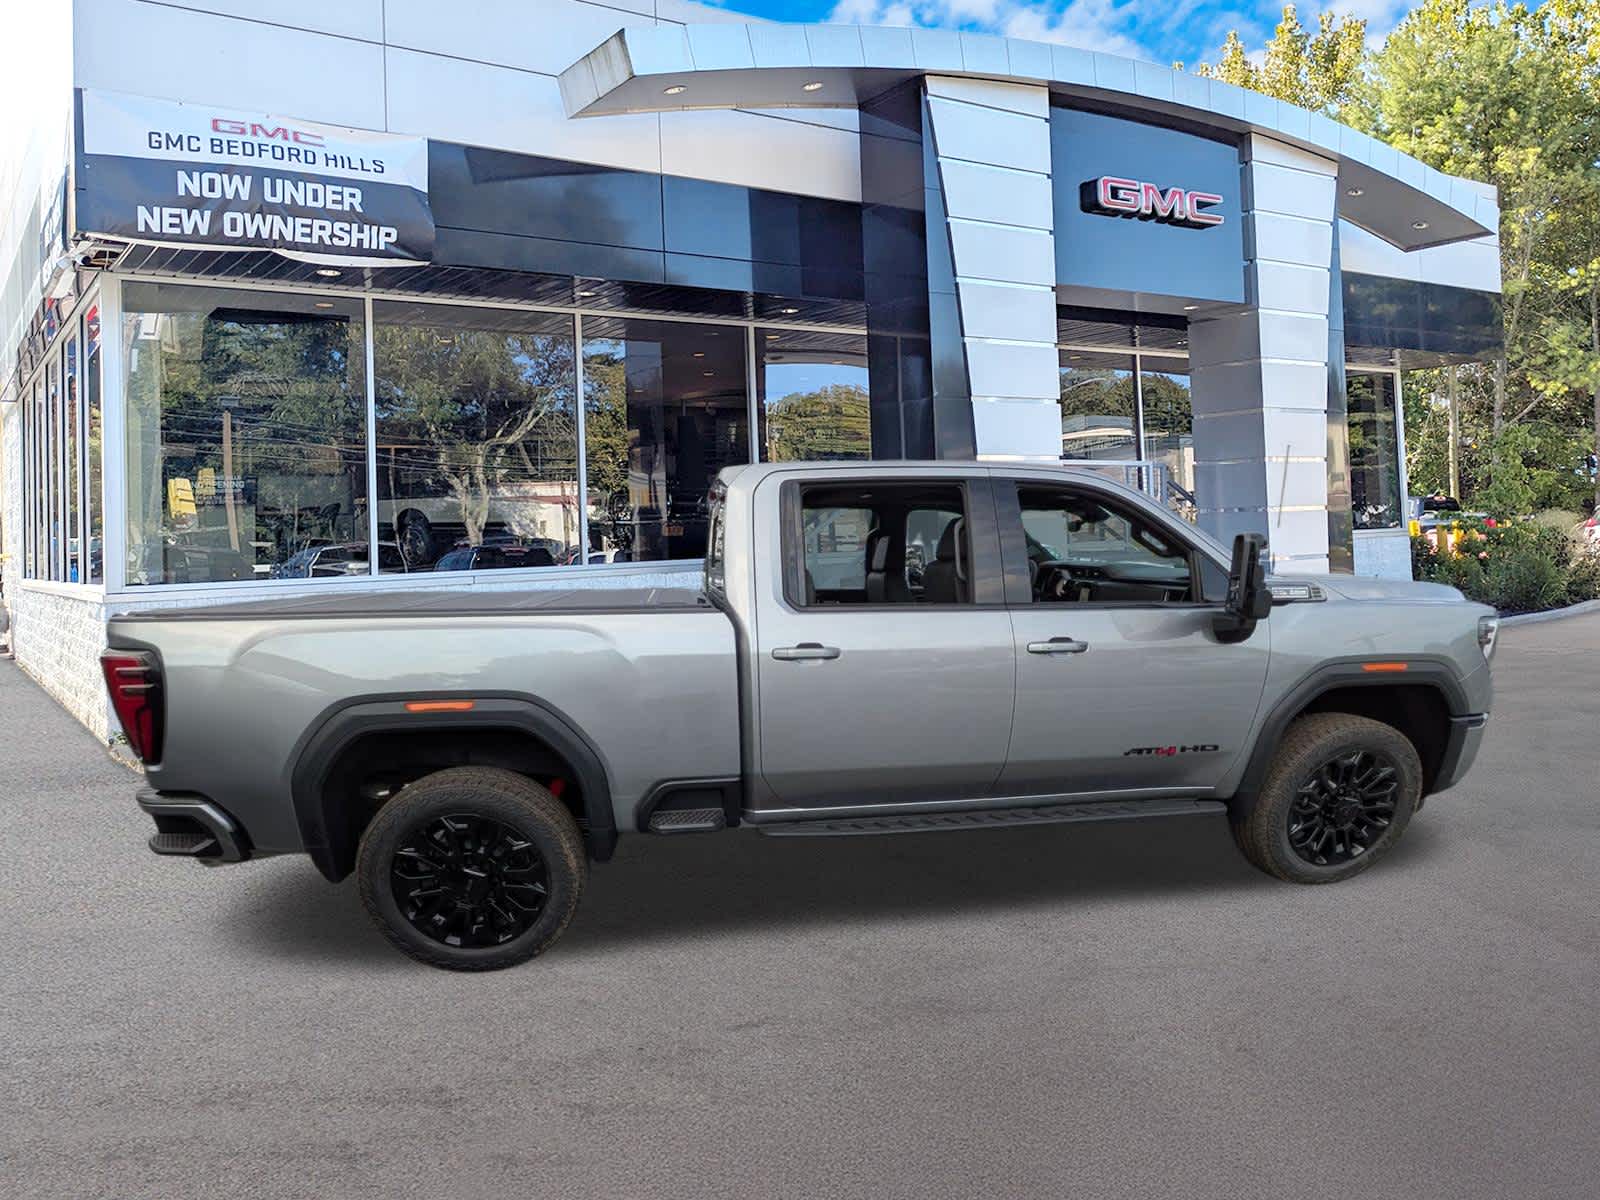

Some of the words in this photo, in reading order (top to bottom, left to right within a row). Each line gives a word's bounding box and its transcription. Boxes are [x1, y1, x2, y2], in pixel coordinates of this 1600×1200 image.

[148, 131, 201, 152] GMC
[210, 139, 316, 165] BEDFORD
[325, 154, 385, 174] HILLS
[212, 118, 326, 148] GMC
[177, 171, 251, 200] NOW
[263, 177, 363, 212] UNDER
[1098, 176, 1224, 224] GMC
[137, 206, 211, 235] NEW
[224, 211, 398, 250] OWNERSHIP
